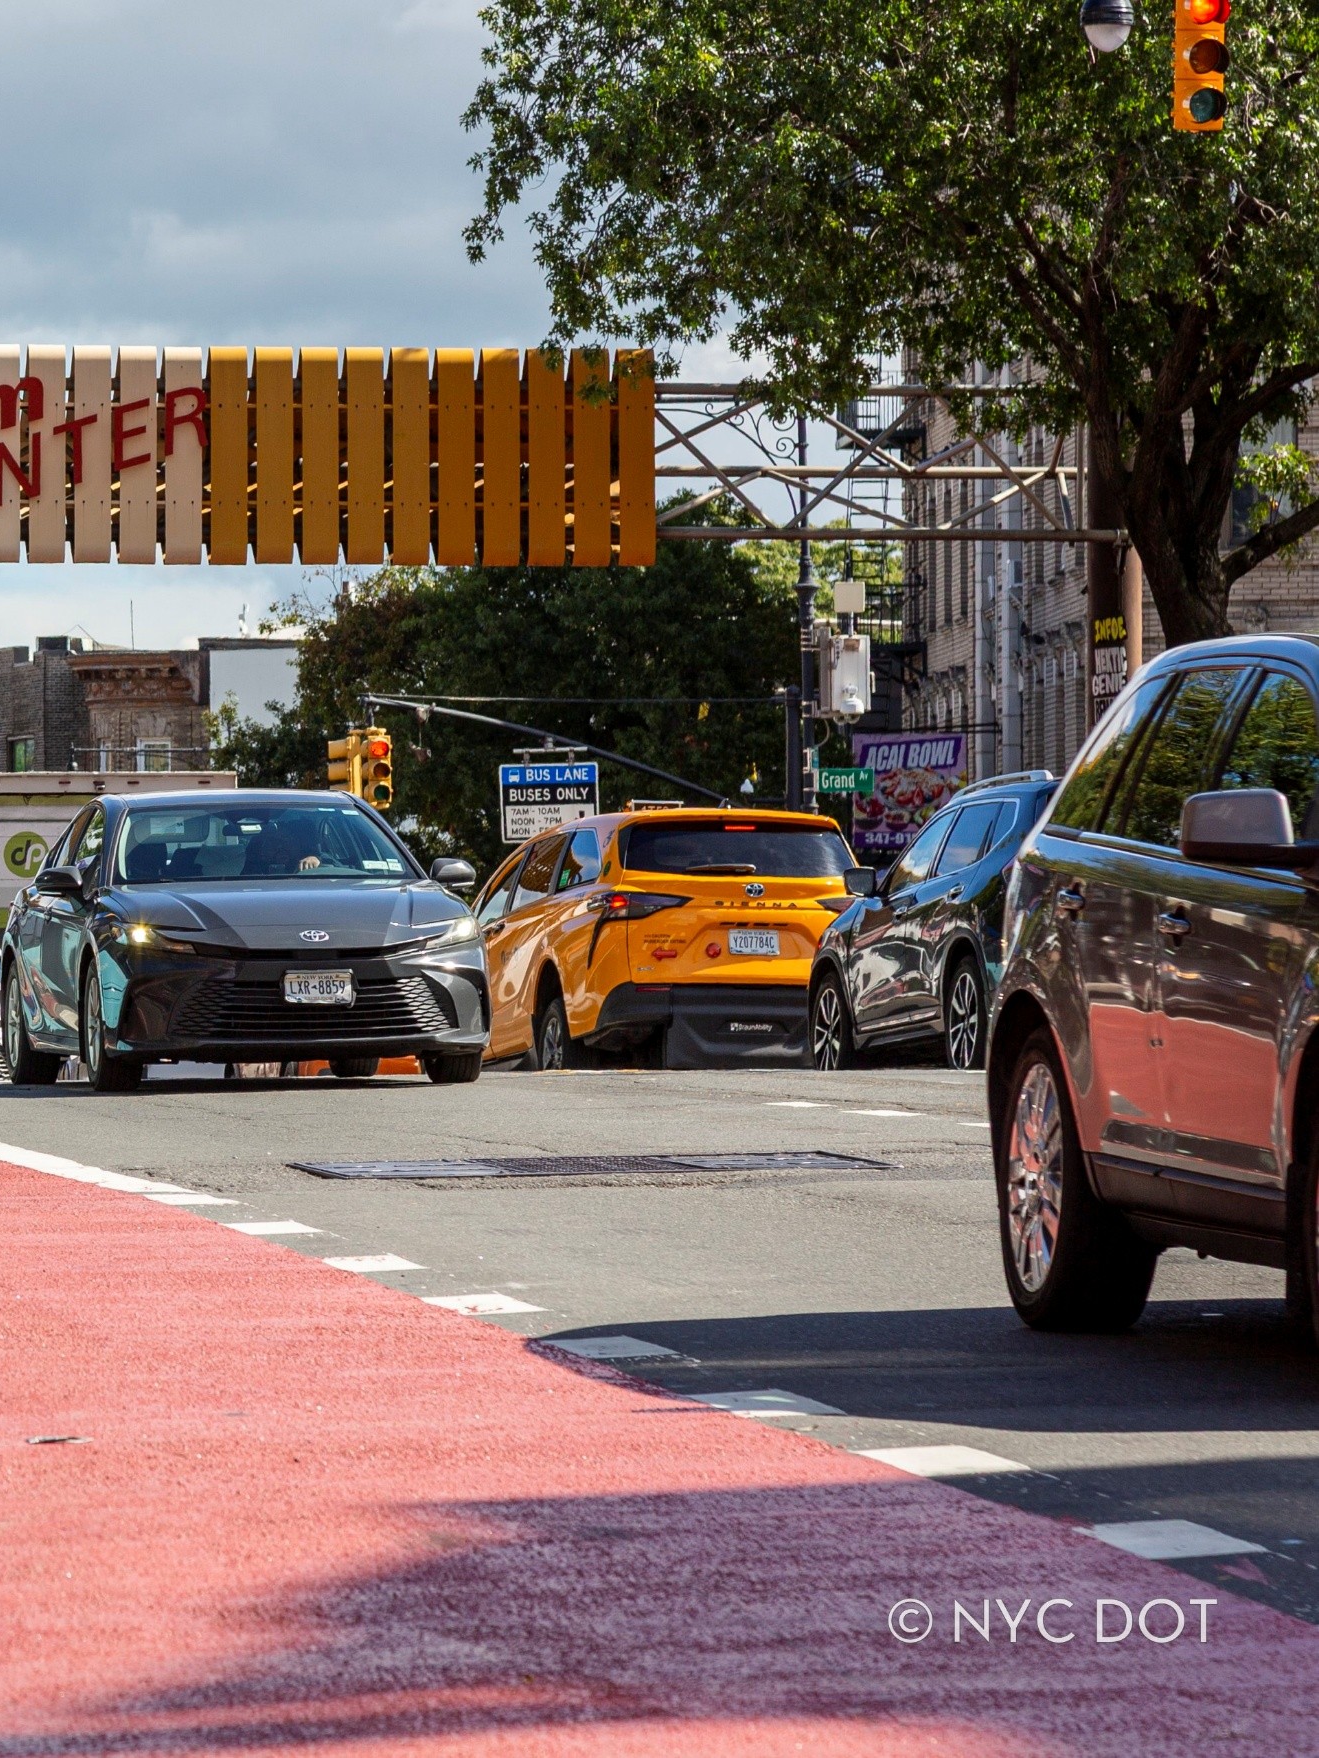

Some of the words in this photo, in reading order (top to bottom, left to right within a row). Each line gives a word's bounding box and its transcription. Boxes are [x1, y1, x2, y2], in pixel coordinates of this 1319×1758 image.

[1094, 646, 1127, 675] HEKTIC
[907, 739, 955, 769] BOWL
[525, 768, 551, 782] BUS
[555, 767, 589, 781] LANE
[821, 772, 855, 790] Grand
[859, 770, 869, 781] Av
[509, 787, 551, 802] BUSES
[556, 787, 589, 800] ONLY
[511, 808, 530, 816] 7AM
[537, 807, 561, 816] 10AM
[511, 818, 535, 826] NOON
[544, 817, 562, 825] 7PM
[511, 827, 531, 836] MON
[715, 900, 797, 909] SIENNA
[733, 936, 775, 949] Y207784C
